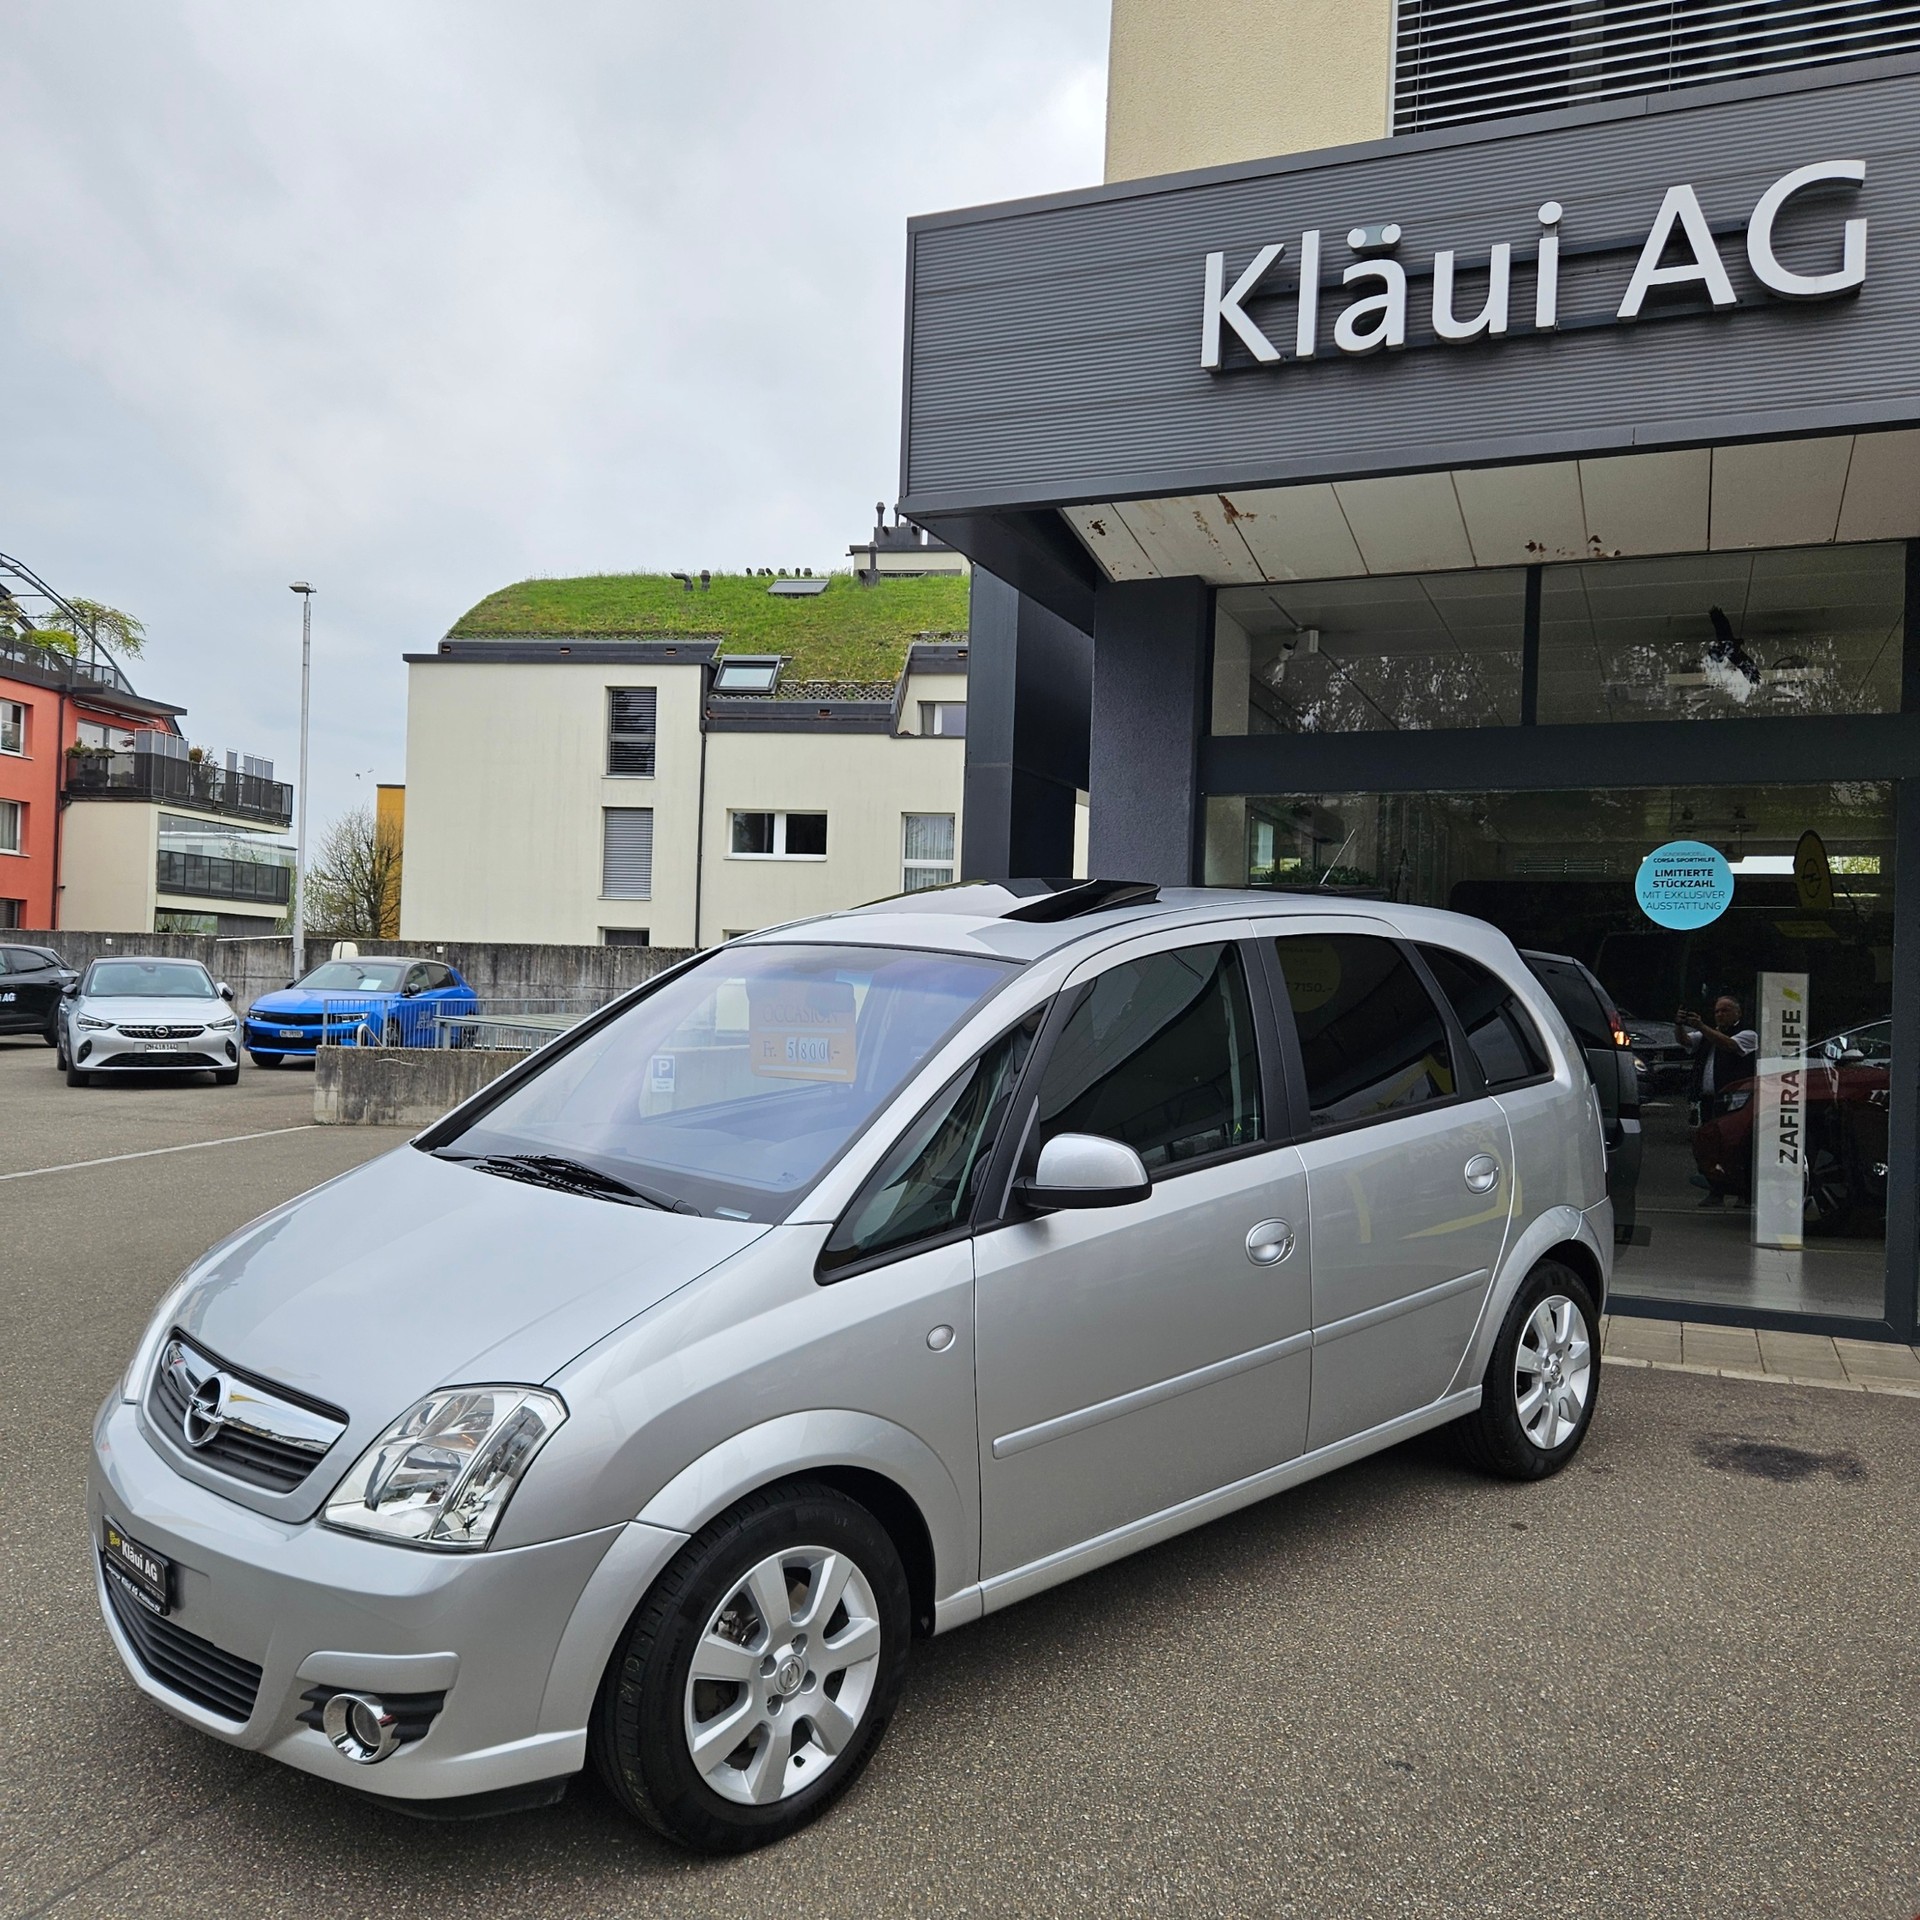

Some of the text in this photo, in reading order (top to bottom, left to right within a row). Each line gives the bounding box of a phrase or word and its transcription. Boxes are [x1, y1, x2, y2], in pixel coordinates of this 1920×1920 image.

[1201, 159, 1868, 369] Kläui AG
[1655, 869, 1714, 877] LIMITIERTE
[1652, 879, 1716, 888] STÜCKZAHL
[1642, 891, 1725, 899] MIT EXKLUSIVER
[1646, 901, 1722, 910] AUSSTATTUNG
[2, 992, 16, 1002] AG
[761, 1003, 839, 1023] OCCASION
[762, 1040, 777, 1057] Fr.
[658, 1060, 671, 1076] P
[1779, 1009, 1801, 1164] ZAFIRA LIFE
[121, 1539, 143, 1571] Kläui
[144, 1559, 158, 1582] AG
